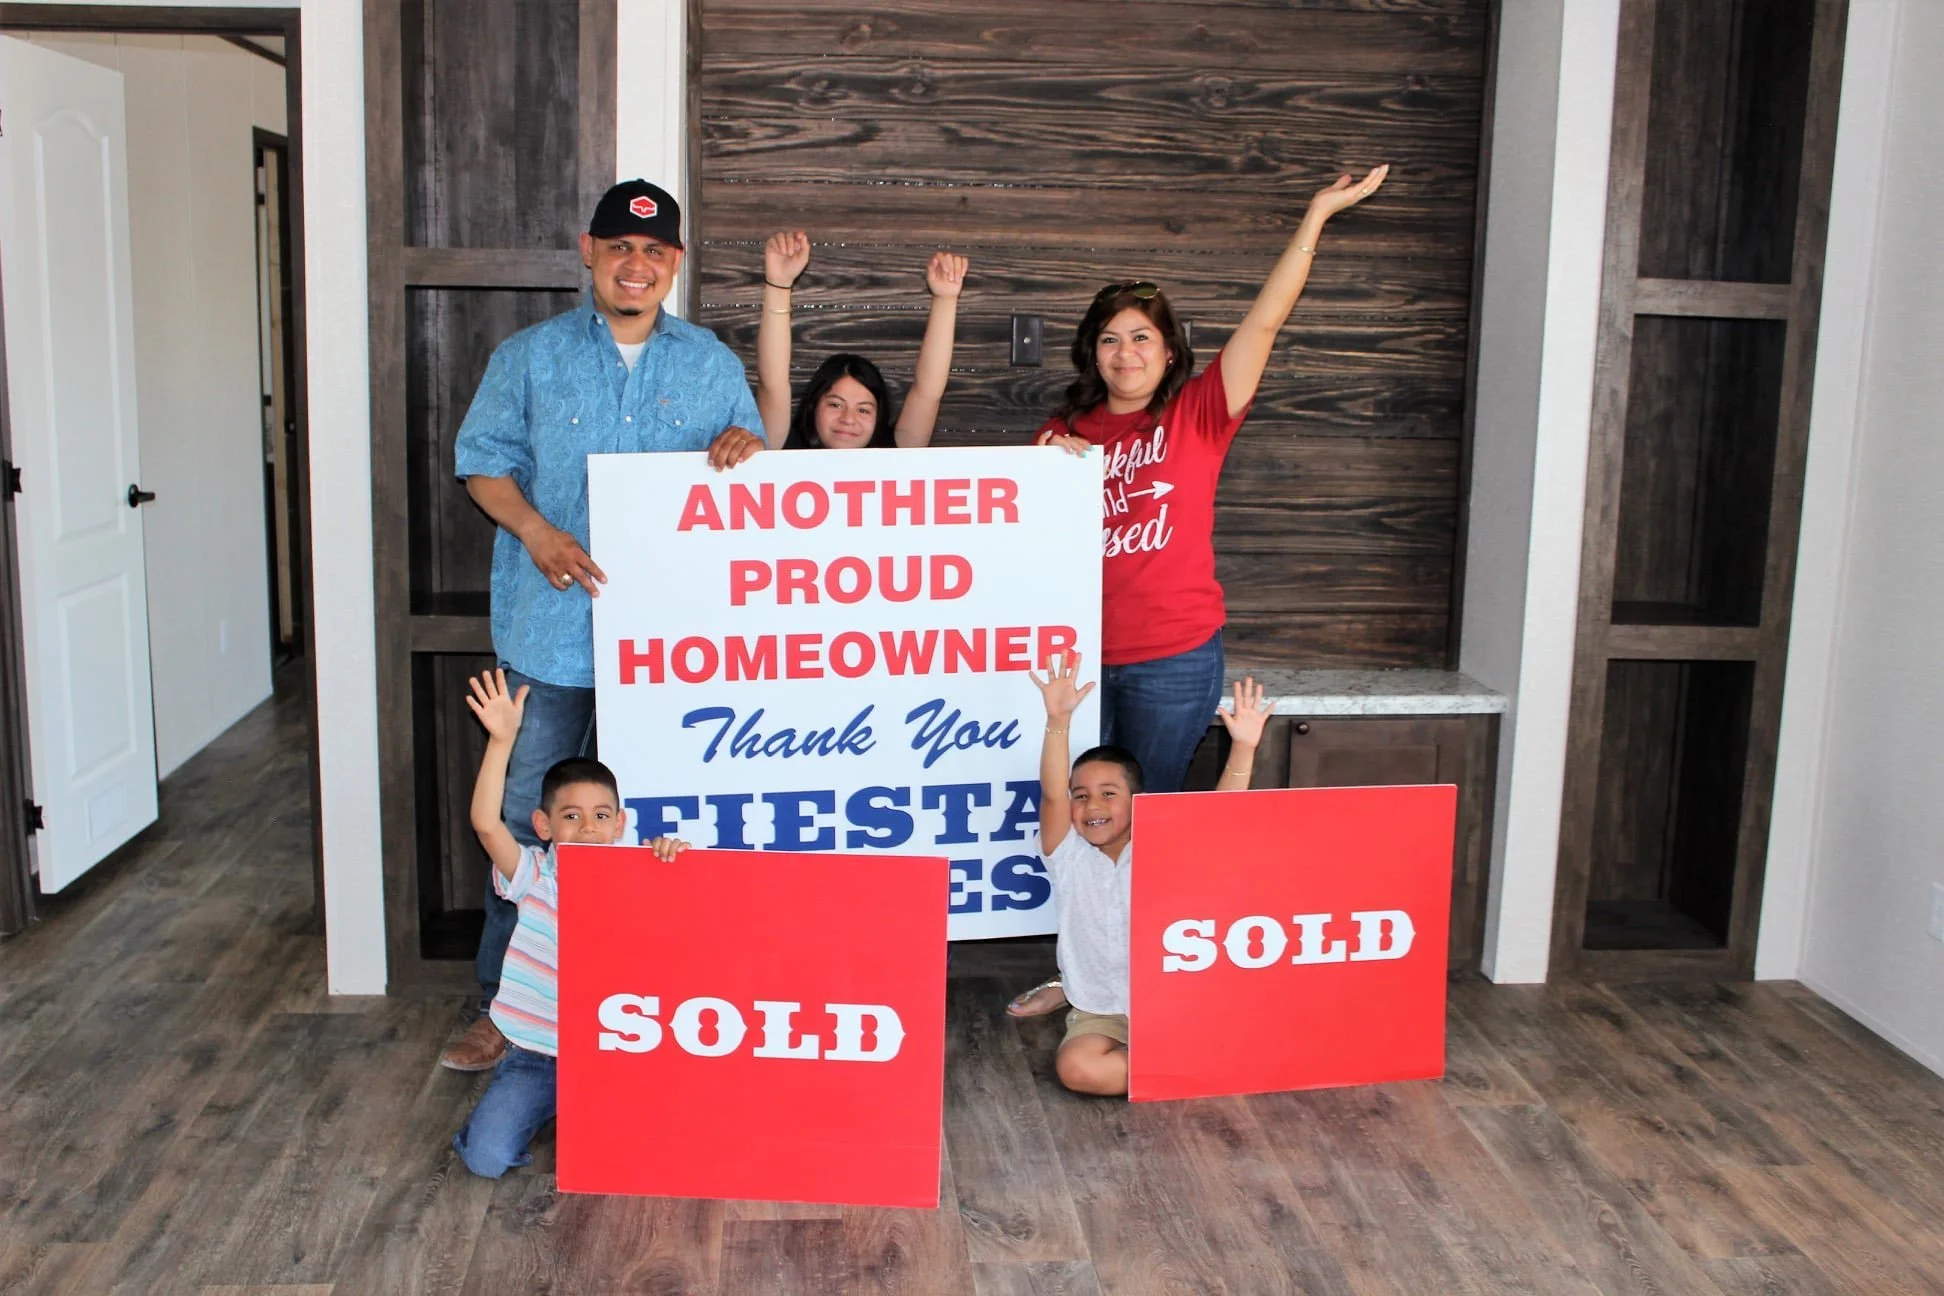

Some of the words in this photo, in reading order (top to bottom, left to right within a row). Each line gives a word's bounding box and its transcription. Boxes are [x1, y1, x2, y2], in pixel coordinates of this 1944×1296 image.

[676, 477, 1019, 532] ANOTHER
[729, 554, 974, 607] PROUD
[618, 625, 1077, 685] HOMEOWNER
[682, 703, 876, 764] Thank
[904, 698, 1021, 769] You
[624, 780, 1042, 851] FIESTA
[948, 854, 1051, 915] ES
[1162, 909, 1416, 973] SOLD
[597, 993, 906, 1062] SOLD
